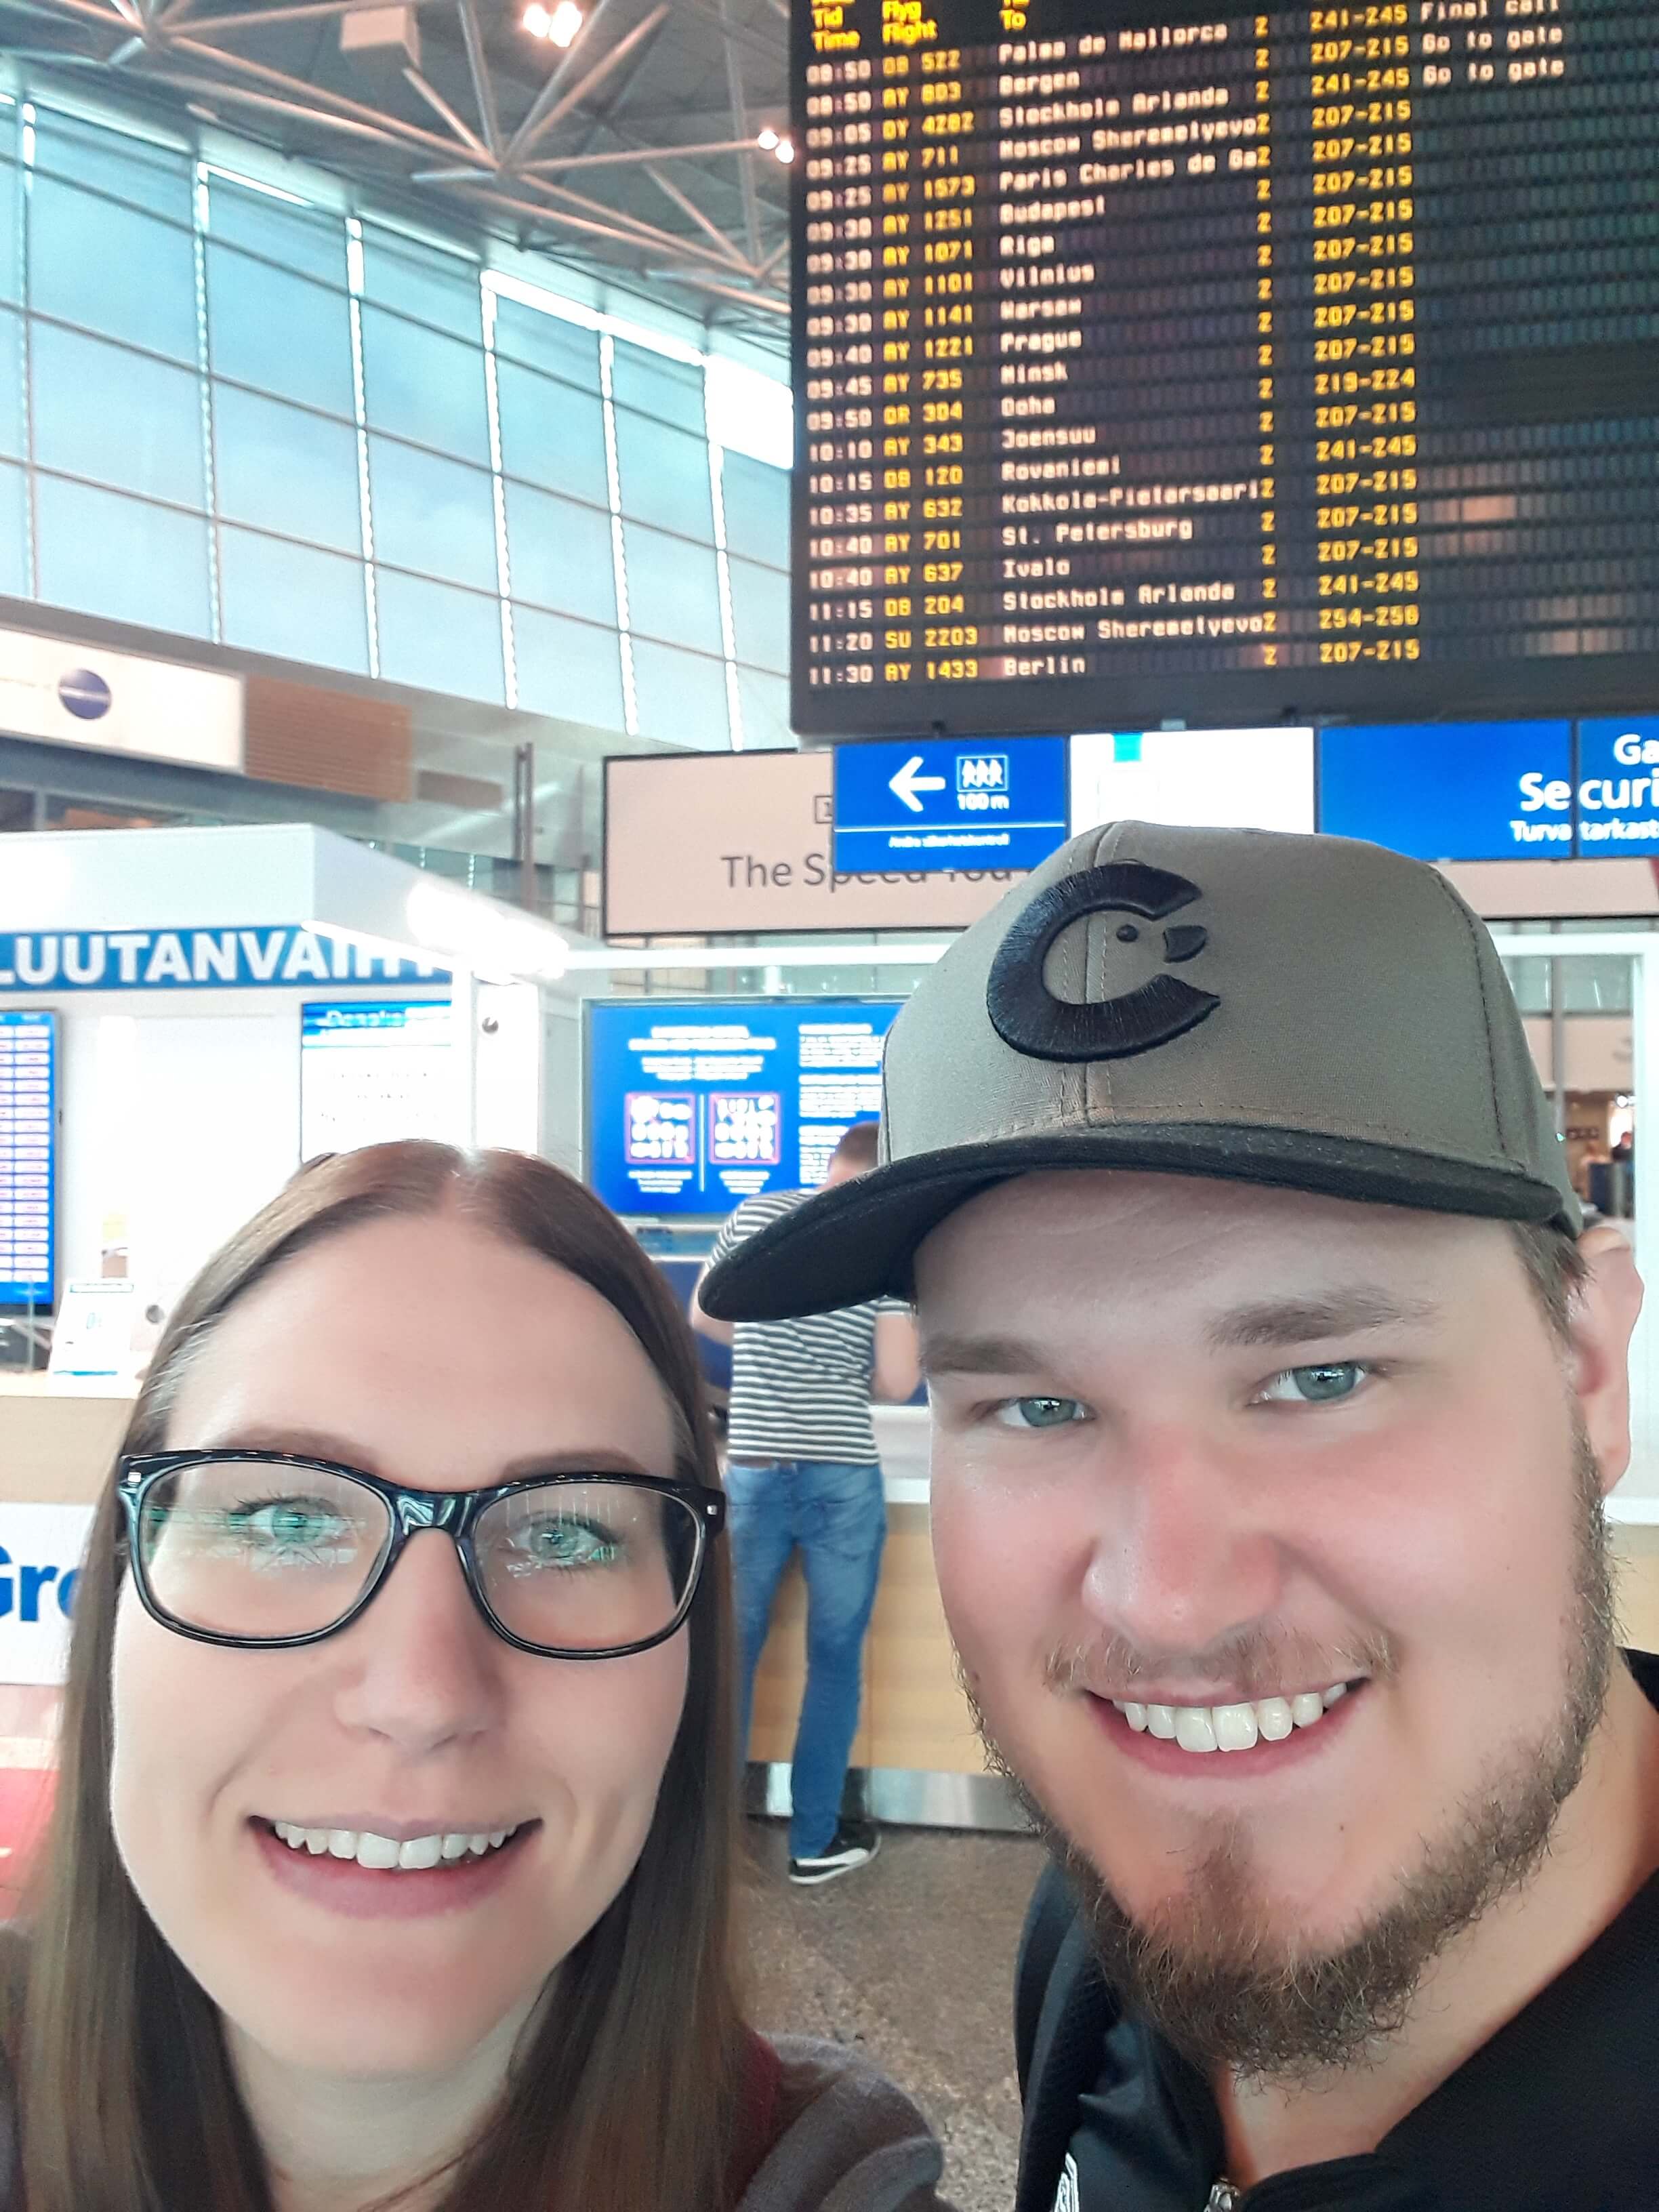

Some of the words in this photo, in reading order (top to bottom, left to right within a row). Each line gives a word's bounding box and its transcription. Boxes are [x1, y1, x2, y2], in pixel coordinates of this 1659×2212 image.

[999, 8, 1027, 30] To
[1255, 16, 1268, 36] 2
[812, 29, 861, 52] Time
[1256, 48, 1269, 68] 2
[1256, 81, 1269, 101] 2
[1256, 113, 1269, 134] 2
[1257, 146, 1270, 167] 2
[1257, 179, 1271, 200] 2
[1257, 212, 1271, 233] 2
[1258, 245, 1271, 266] 2
[1258, 279, 1271, 300] 2
[1258, 312, 1272, 333] 2
[1258, 345, 1272, 366] 2
[1259, 378, 1273, 399] 2
[883, 437, 910, 457] AY
[923, 433, 963, 454] 343
[1002, 427, 1096, 449] Joensuu
[1260, 411, 1273, 432] 2
[1315, 401, 1416, 428] 207-215
[925, 465, 963, 486] 120
[1001, 456, 1120, 481] Rovaniemi
[1260, 445, 1273, 465] 2
[1316, 434, 1416, 462] 241-245
[884, 501, 911, 521] AY
[923, 497, 963, 518] 632
[1261, 478, 1274, 498] 2
[1317, 469, 1417, 495] 207-215
[884, 533, 911, 554] AY
[923, 530, 960, 551] 701
[1002, 526, 1040, 546] St.
[1055, 519, 1193, 544] Petersburg
[1261, 511, 1275, 532] 2
[1317, 502, 1417, 529] 207-215
[883, 565, 912, 585] AY
[923, 562, 964, 583] 637
[1002, 557, 1070, 579] Ivalo
[1262, 544, 1275, 565] 2
[1317, 537, 1418, 562] 207-215
[924, 594, 964, 615] 204
[1002, 587, 1124, 611] Stockholm
[1138, 581, 1235, 605] Arlanda
[1263, 578, 1276, 598] 2
[1318, 571, 1418, 596] 241-245
[884, 630, 912, 649] SU
[924, 626, 978, 647] 2203
[1002, 624, 1085, 644] Moscow
[1263, 611, 1277, 632] 2
[884, 663, 912, 682] AY
[926, 659, 979, 680] 1433
[1003, 655, 1086, 678] Berlin
[1263, 645, 1277, 665] 2
[1319, 638, 1420, 663] 207-215
[958, 794, 990, 811] 100
[991, 794, 1010, 810] m
[721, 855, 792, 888] The
